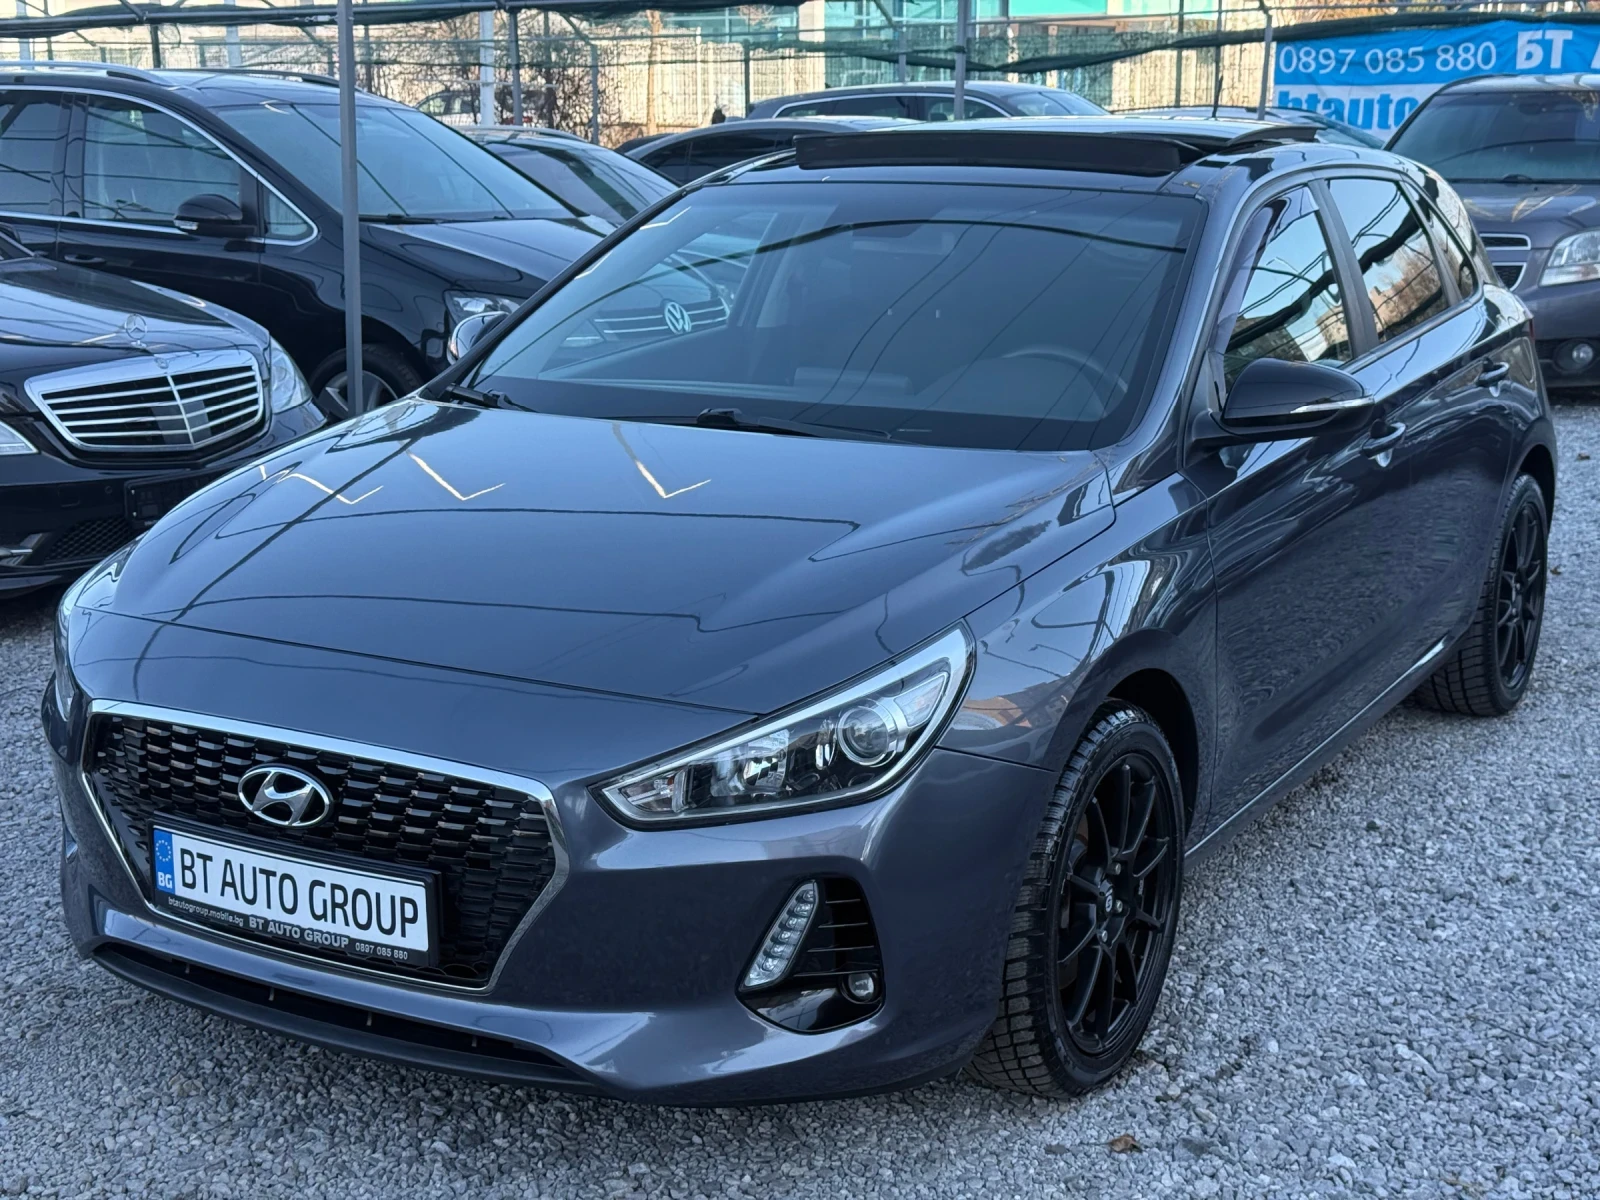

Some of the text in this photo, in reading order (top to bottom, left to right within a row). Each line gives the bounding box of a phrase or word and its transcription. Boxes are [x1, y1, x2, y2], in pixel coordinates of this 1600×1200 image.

[1279, 46, 1356, 74] 0897
[1364, 46, 1425, 73] 085
[1435, 41, 1497, 71] 880
[157, 871, 173, 888] BG
[180, 848, 419, 938] BT AUTO GROUP
[168, 896, 244, 927] btautogroup.mobile.bg
[249, 916, 264, 930] BT
[267, 921, 301, 939] AUTO
[304, 929, 349, 949] GROUP
[355, 942, 375, 955] 0897
